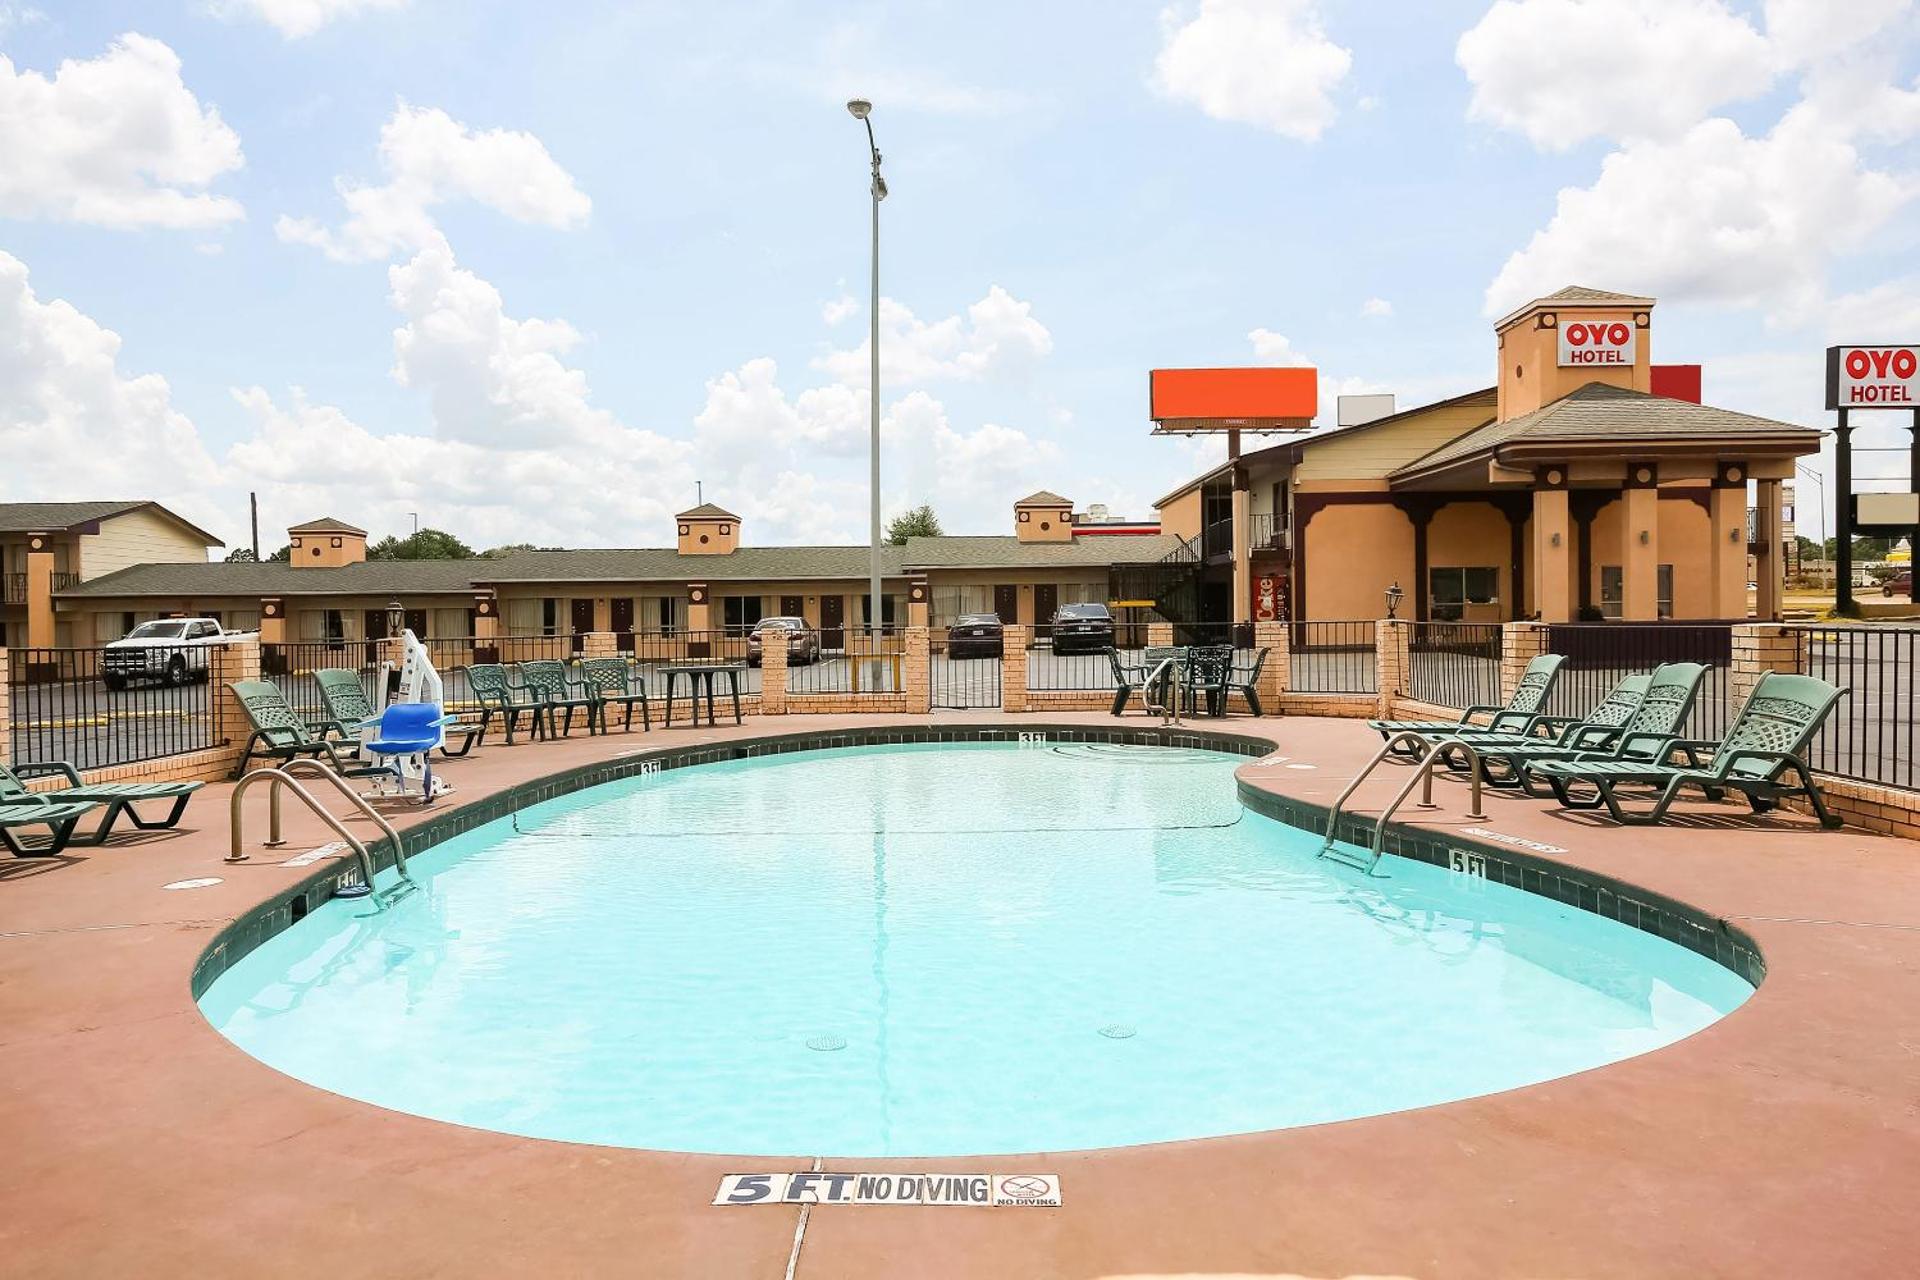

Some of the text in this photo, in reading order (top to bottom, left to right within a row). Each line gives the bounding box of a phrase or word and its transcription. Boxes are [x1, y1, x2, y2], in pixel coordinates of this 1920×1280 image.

[1566, 323, 1629, 346] OYO
[1571, 350, 1625, 363] HOTEL
[1846, 349, 1917, 379] OYO
[1851, 385, 1911, 402] HOTEL
[1256, 578, 1274, 621] Coke
[1453, 852, 1485, 878] 5 FT
[727, 1174, 988, 1202] 5 FT. NO DIVING
